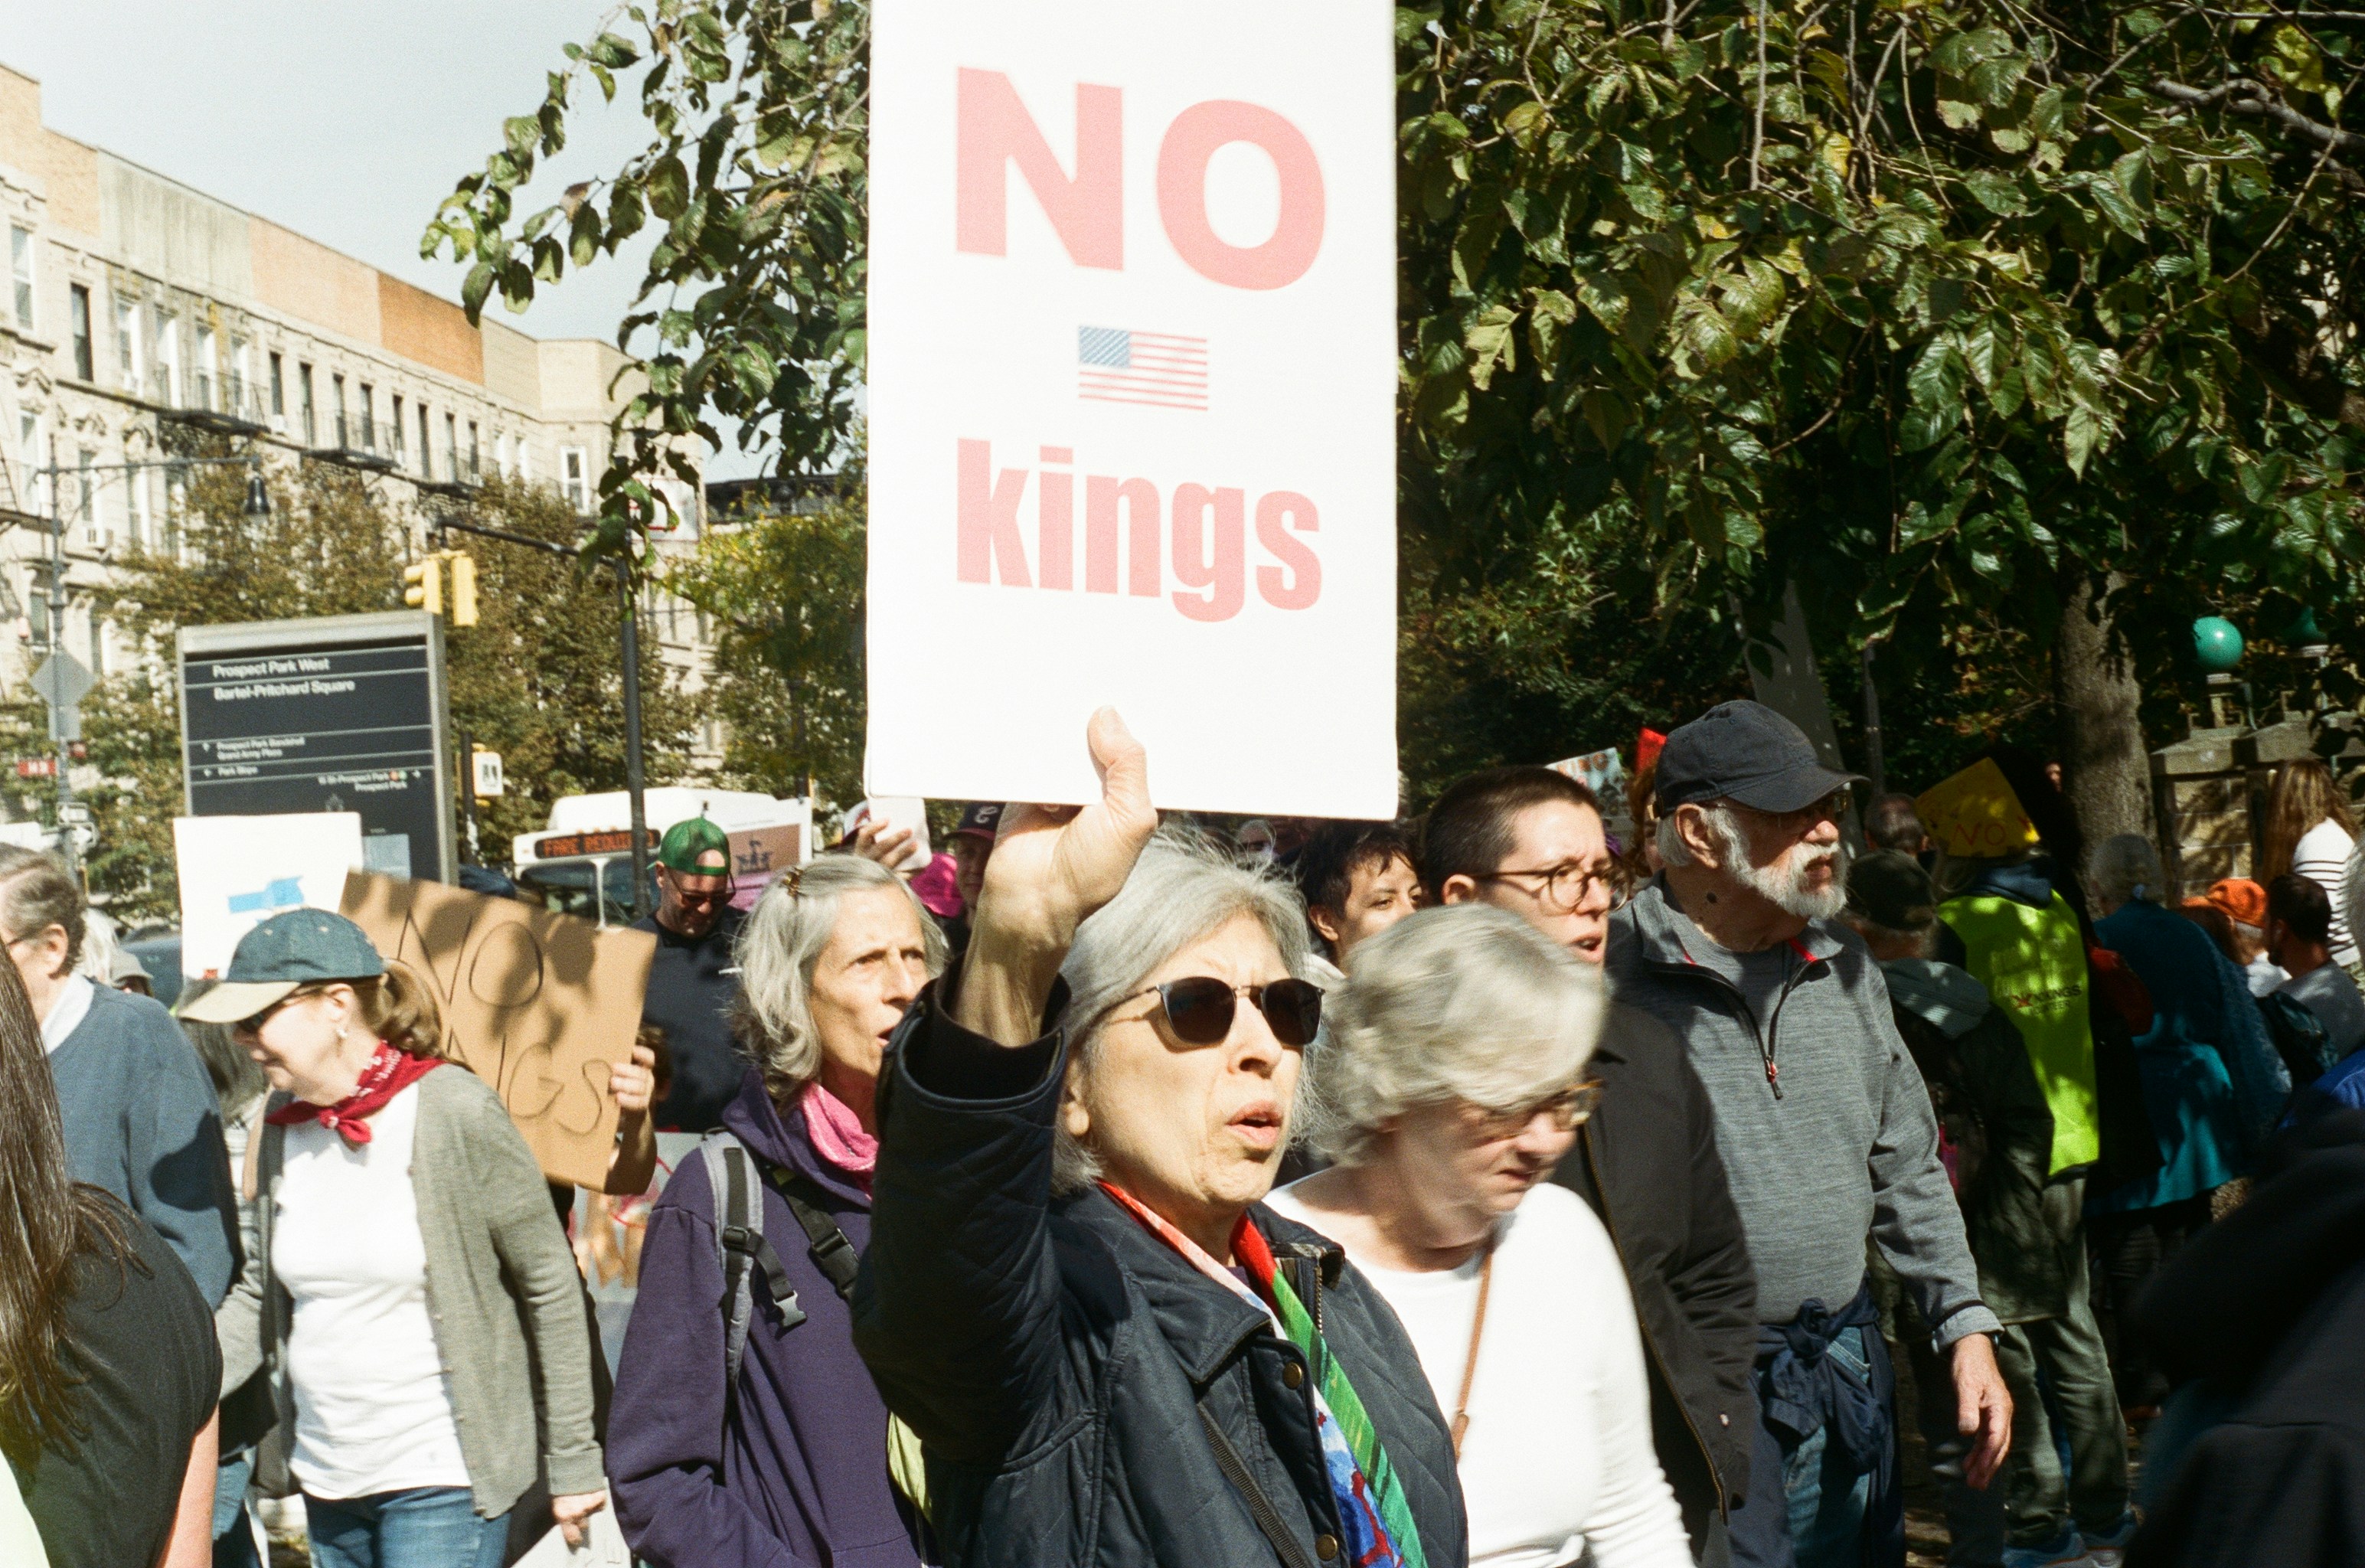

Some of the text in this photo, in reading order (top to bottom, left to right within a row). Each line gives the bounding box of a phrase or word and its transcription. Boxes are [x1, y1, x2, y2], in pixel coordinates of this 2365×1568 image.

[956, 66, 1326, 291] NO
[957, 437, 1322, 623] kings
[212, 658, 330, 678] Prospect Park West
[214, 680, 355, 701] Bartel-Pritchard Square
[1952, 823, 2006, 846] NO
[397, 907, 544, 1009] NO
